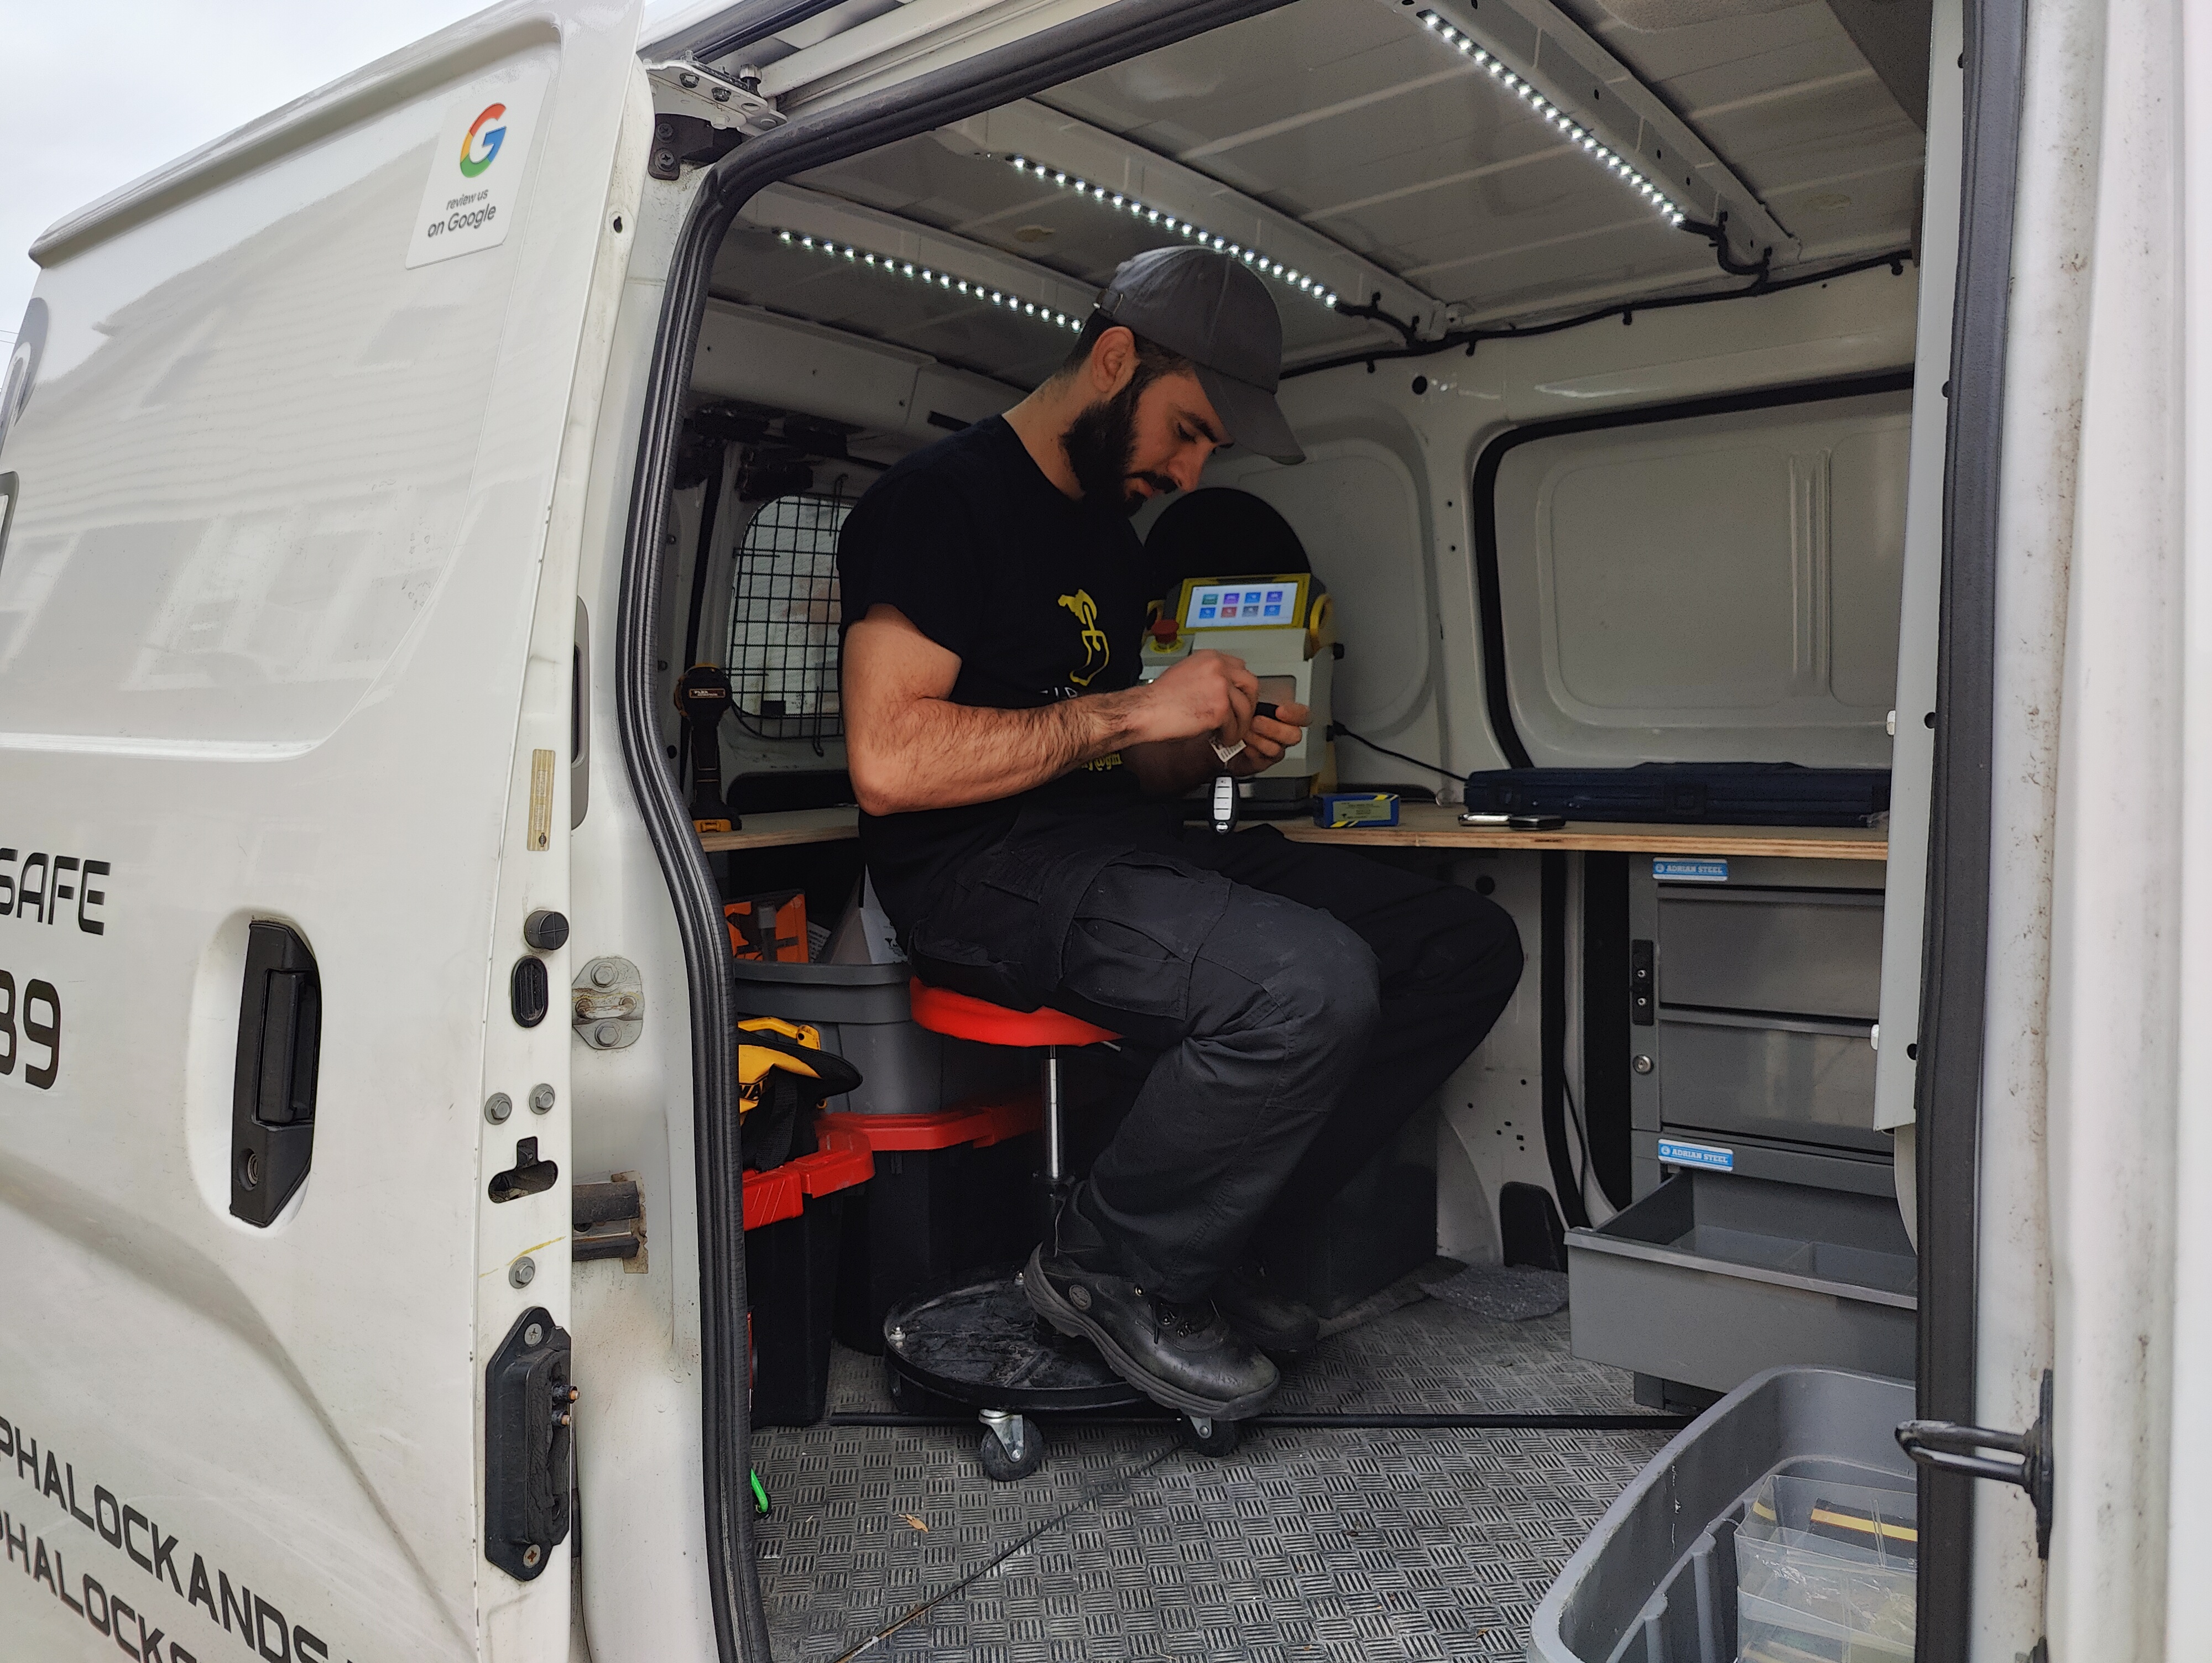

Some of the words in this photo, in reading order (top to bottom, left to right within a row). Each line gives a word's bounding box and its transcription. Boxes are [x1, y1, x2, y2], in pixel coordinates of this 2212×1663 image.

[427, 221, 445, 238] on
[448, 202, 497, 232] Google
[446, 194, 477, 211] review
[477, 189, 489, 201] us
[0, 848, 111, 936] SAFE
[1672, 1148, 1702, 1159] ADRIAN
[1703, 1154, 1728, 1163] STEEL
[0, 1416, 354, 1663] PHALOCKANDS
[0, 1508, 197, 1663] HALOCK
